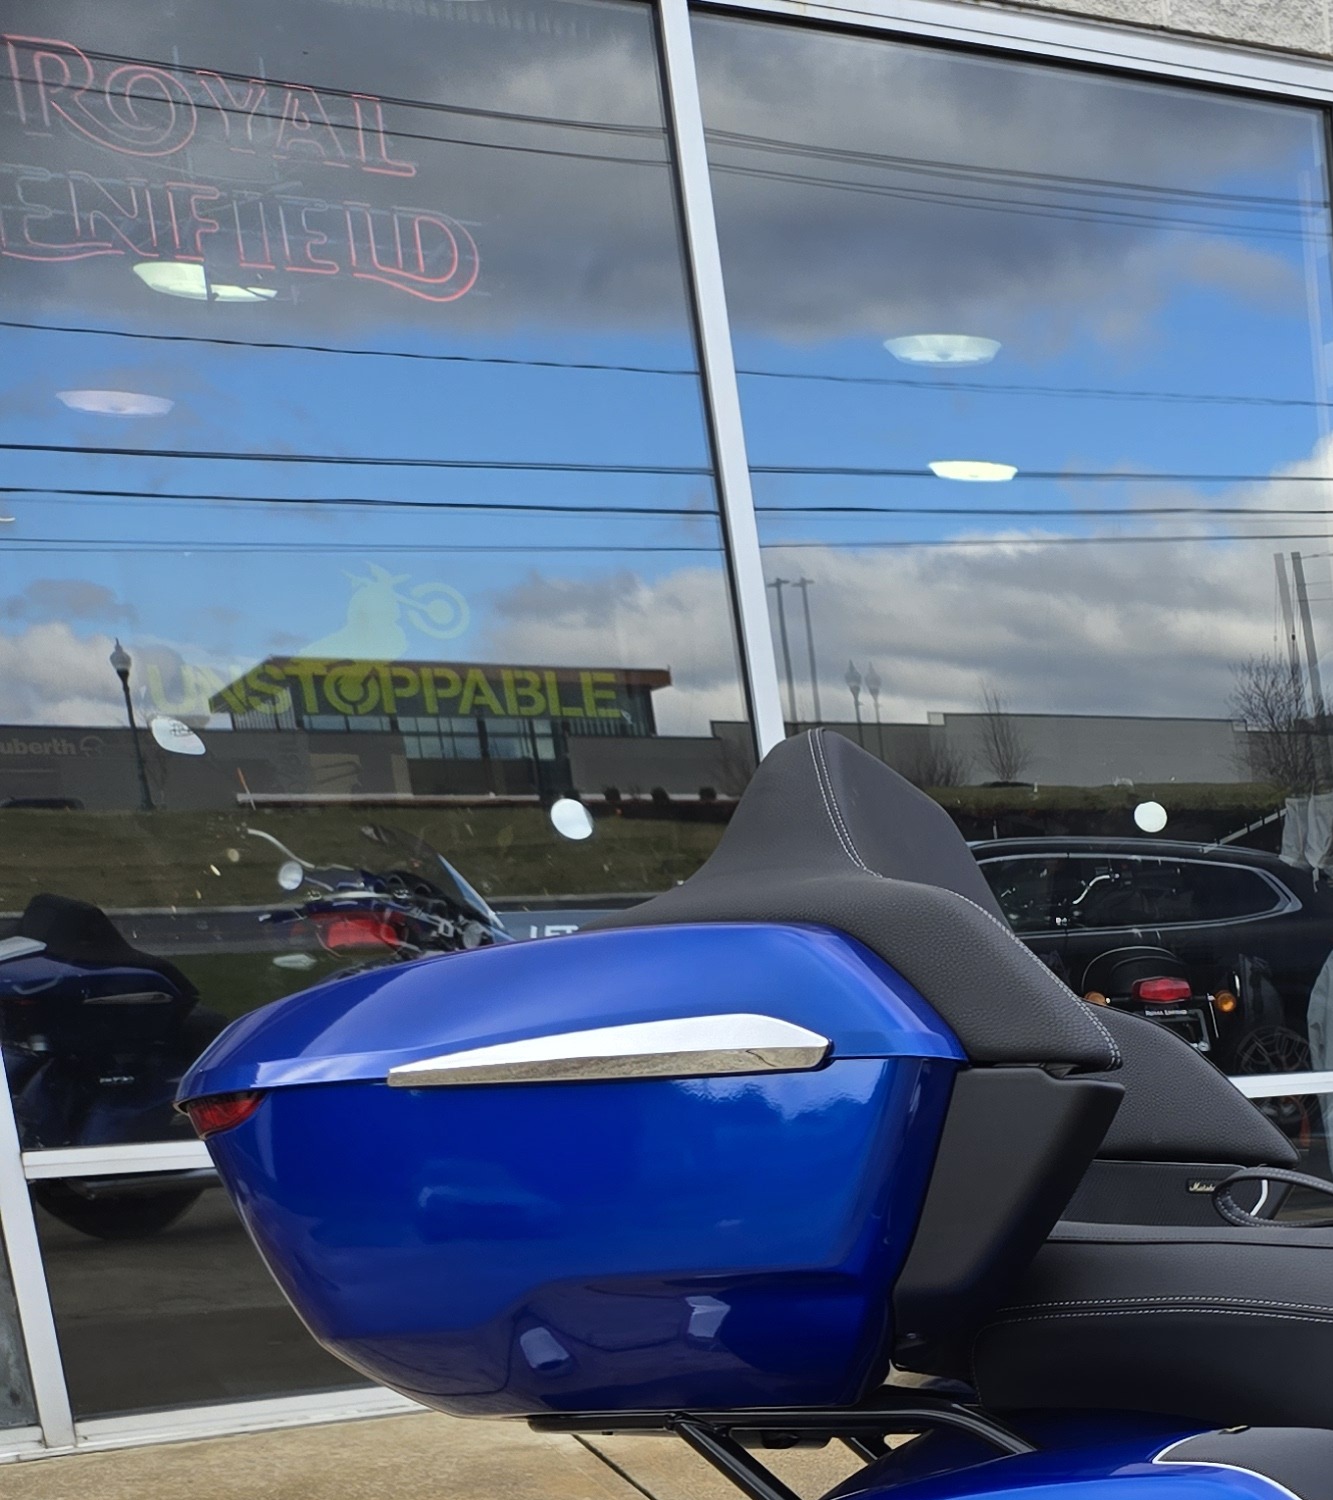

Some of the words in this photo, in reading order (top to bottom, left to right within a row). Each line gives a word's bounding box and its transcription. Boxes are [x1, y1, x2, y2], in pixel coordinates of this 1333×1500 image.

[2, 34, 416, 177] ROYAL
[0, 162, 480, 301] ENFIELD
[146, 655, 623, 720] UNSTOPPABLE
